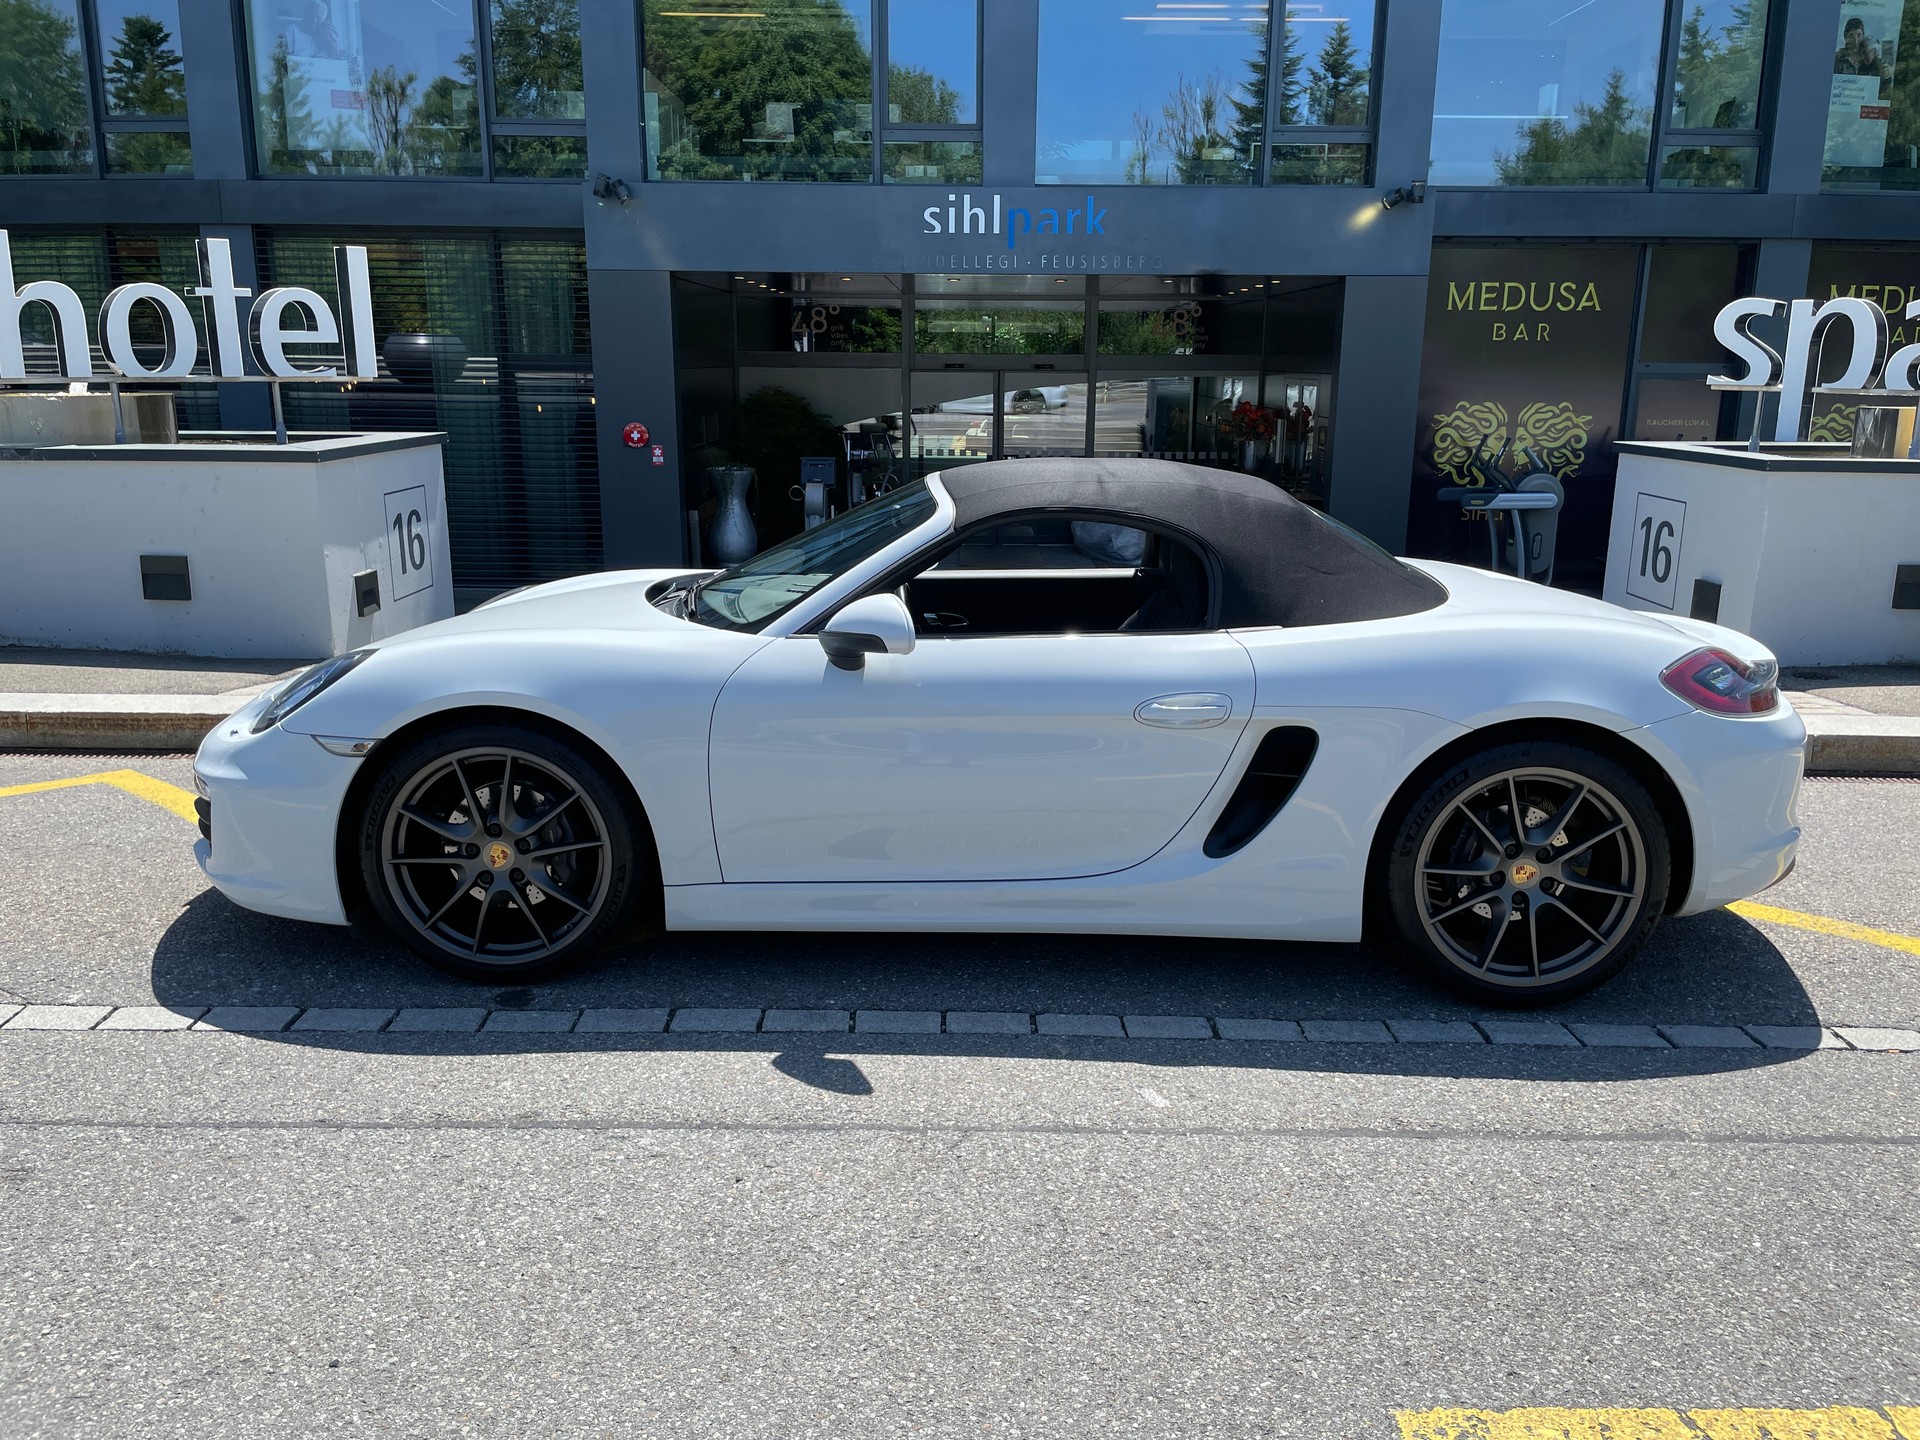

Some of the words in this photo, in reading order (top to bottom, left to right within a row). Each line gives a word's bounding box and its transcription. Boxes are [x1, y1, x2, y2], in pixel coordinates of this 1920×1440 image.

[923, 194, 1108, 249] sihlpark
[0, 229, 378, 378] hotel
[1447, 281, 1602, 312] MEDUSA
[1492, 323, 1551, 342] BAR
[392, 509, 426, 575] 16
[1639, 517, 1675, 583] 16
[1408, 771, 1467, 838] MICHELIN
